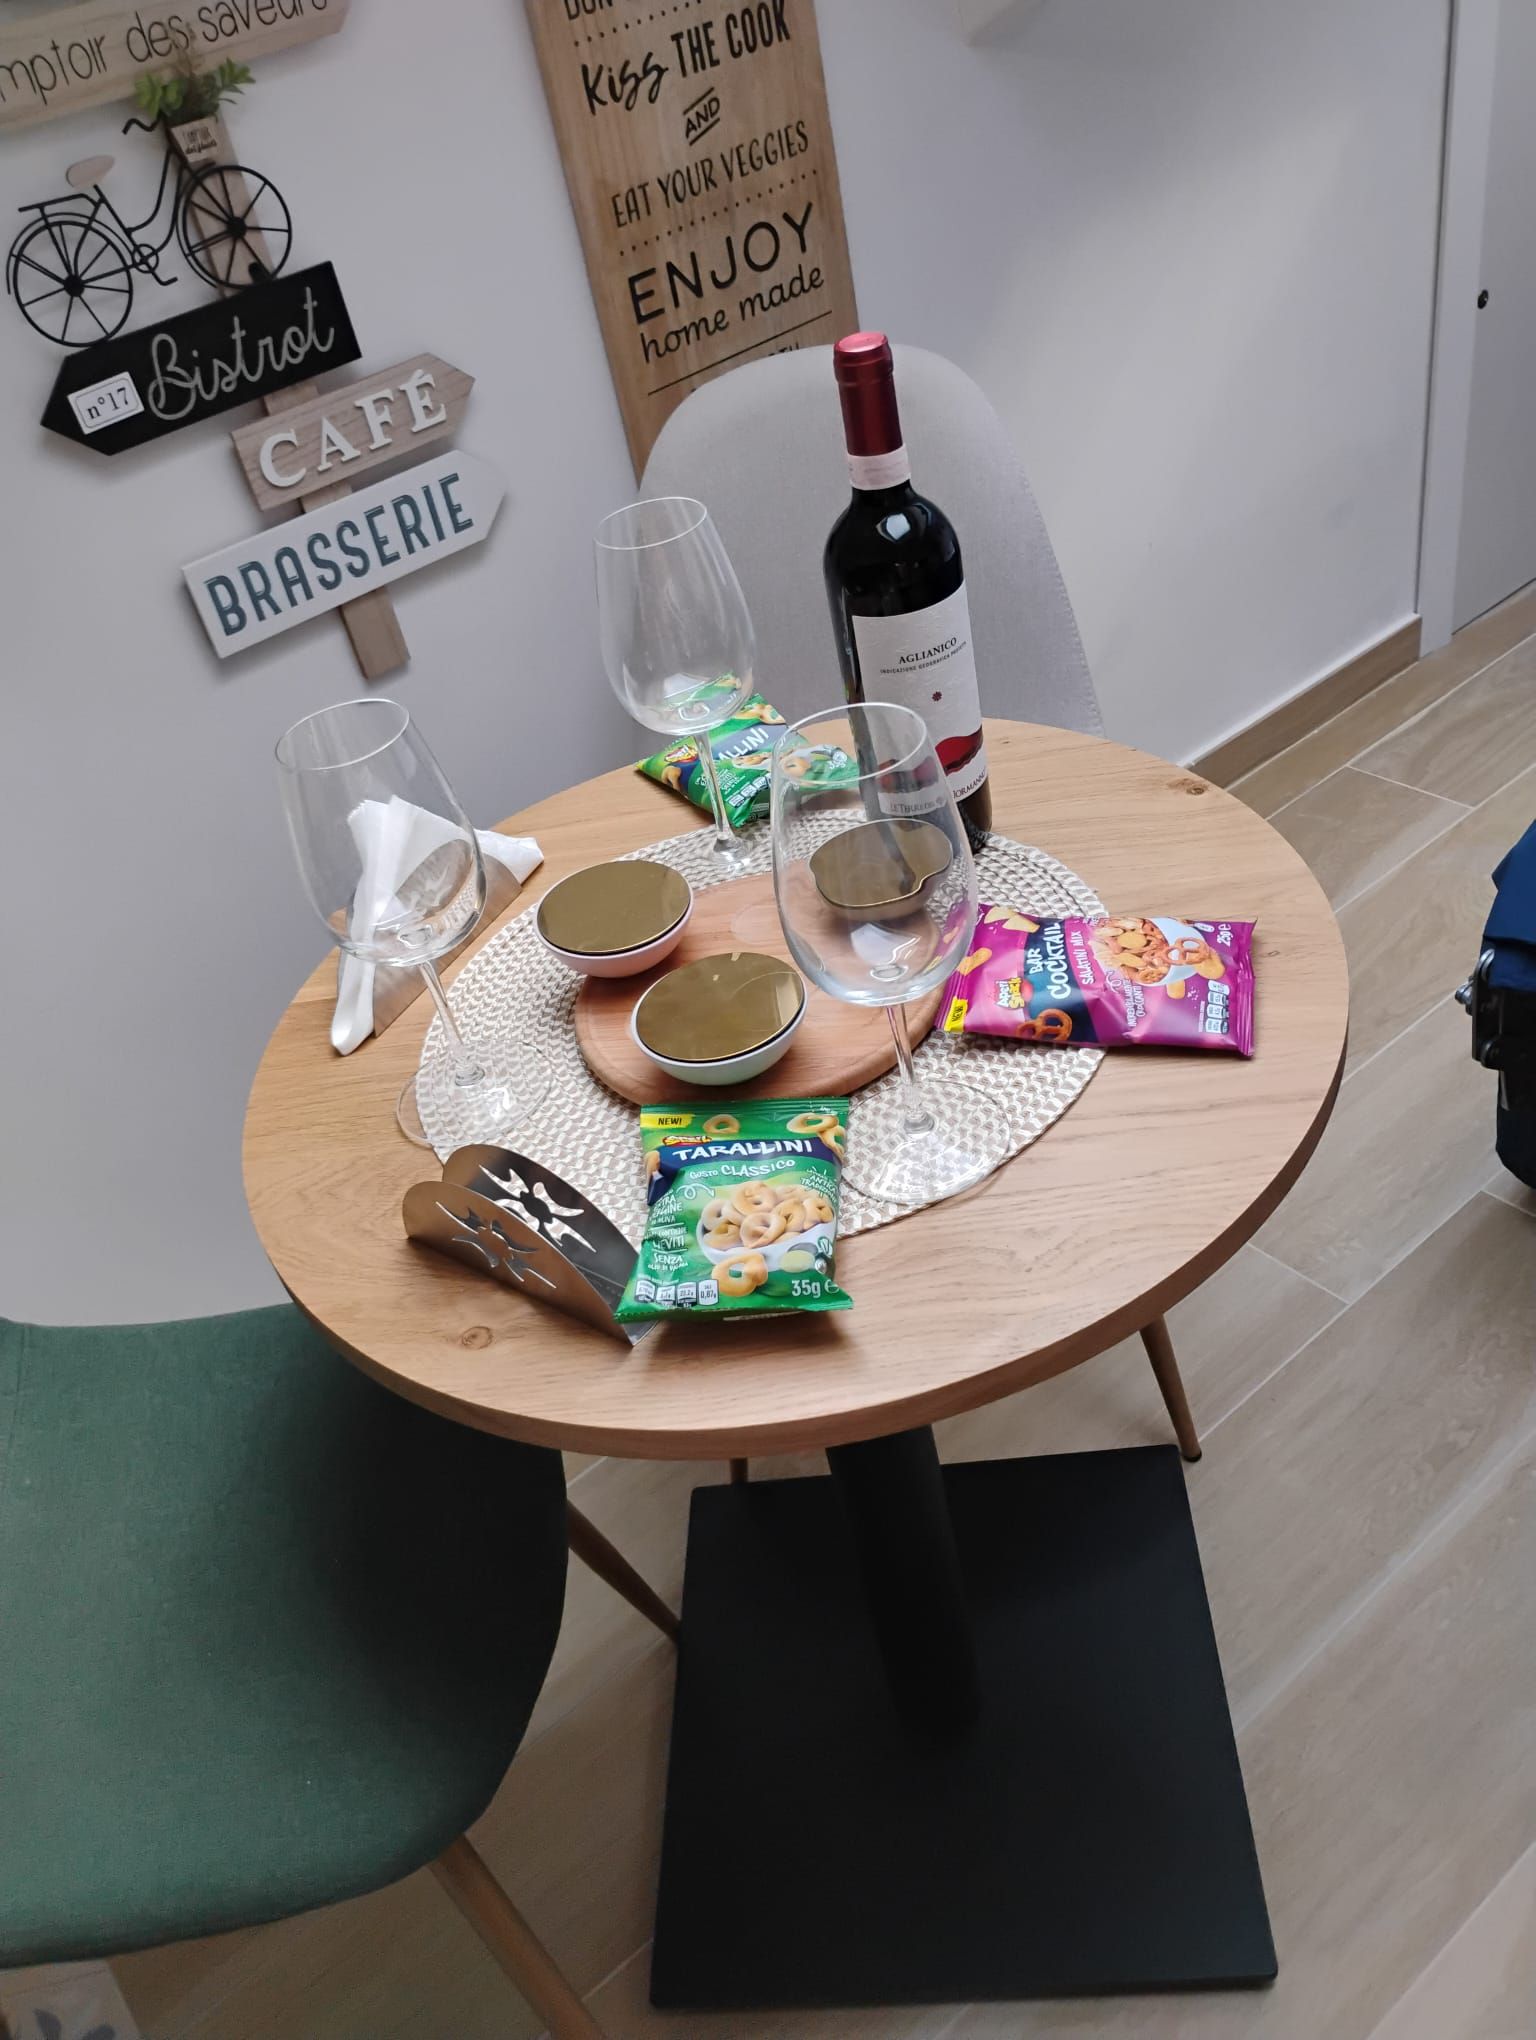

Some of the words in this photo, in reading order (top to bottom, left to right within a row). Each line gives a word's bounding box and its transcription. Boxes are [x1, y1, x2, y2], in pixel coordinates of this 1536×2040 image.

[126, 11, 190, 63] des
[581, 52, 668, 116] Kiss
[671, 21, 720, 78] THE
[725, 0, 791, 59] COOK
[684, 96, 721, 139] AND
[612, 182, 650, 228] EAT
[657, 157, 718, 208] YOUR
[720, 120, 809, 183] VEGGIES
[628, 202, 813, 325] ENJOY
[640, 309, 729, 363] home
[739, 264, 824, 321] made
[147, 286, 335, 420] Bistrot
[259, 369, 448, 488] CAFÉ
[203, 472, 474, 636] BRASSERIE
[898, 637, 957, 664] AGLIANICO
[1069, 930, 1084, 947] MIX
[1026, 948, 1044, 975] BAR
[1043, 922, 1072, 1000] COCKTAIL
[1073, 948, 1095, 985] SALATINI
[658, 1116, 683, 1126] NEW!
[672, 1139, 813, 1162] TARALLINI
[721, 1159, 796, 1177] CLASSICO
[654, 1252, 683, 1266] SENZA
[791, 1279, 821, 1299] 35g
